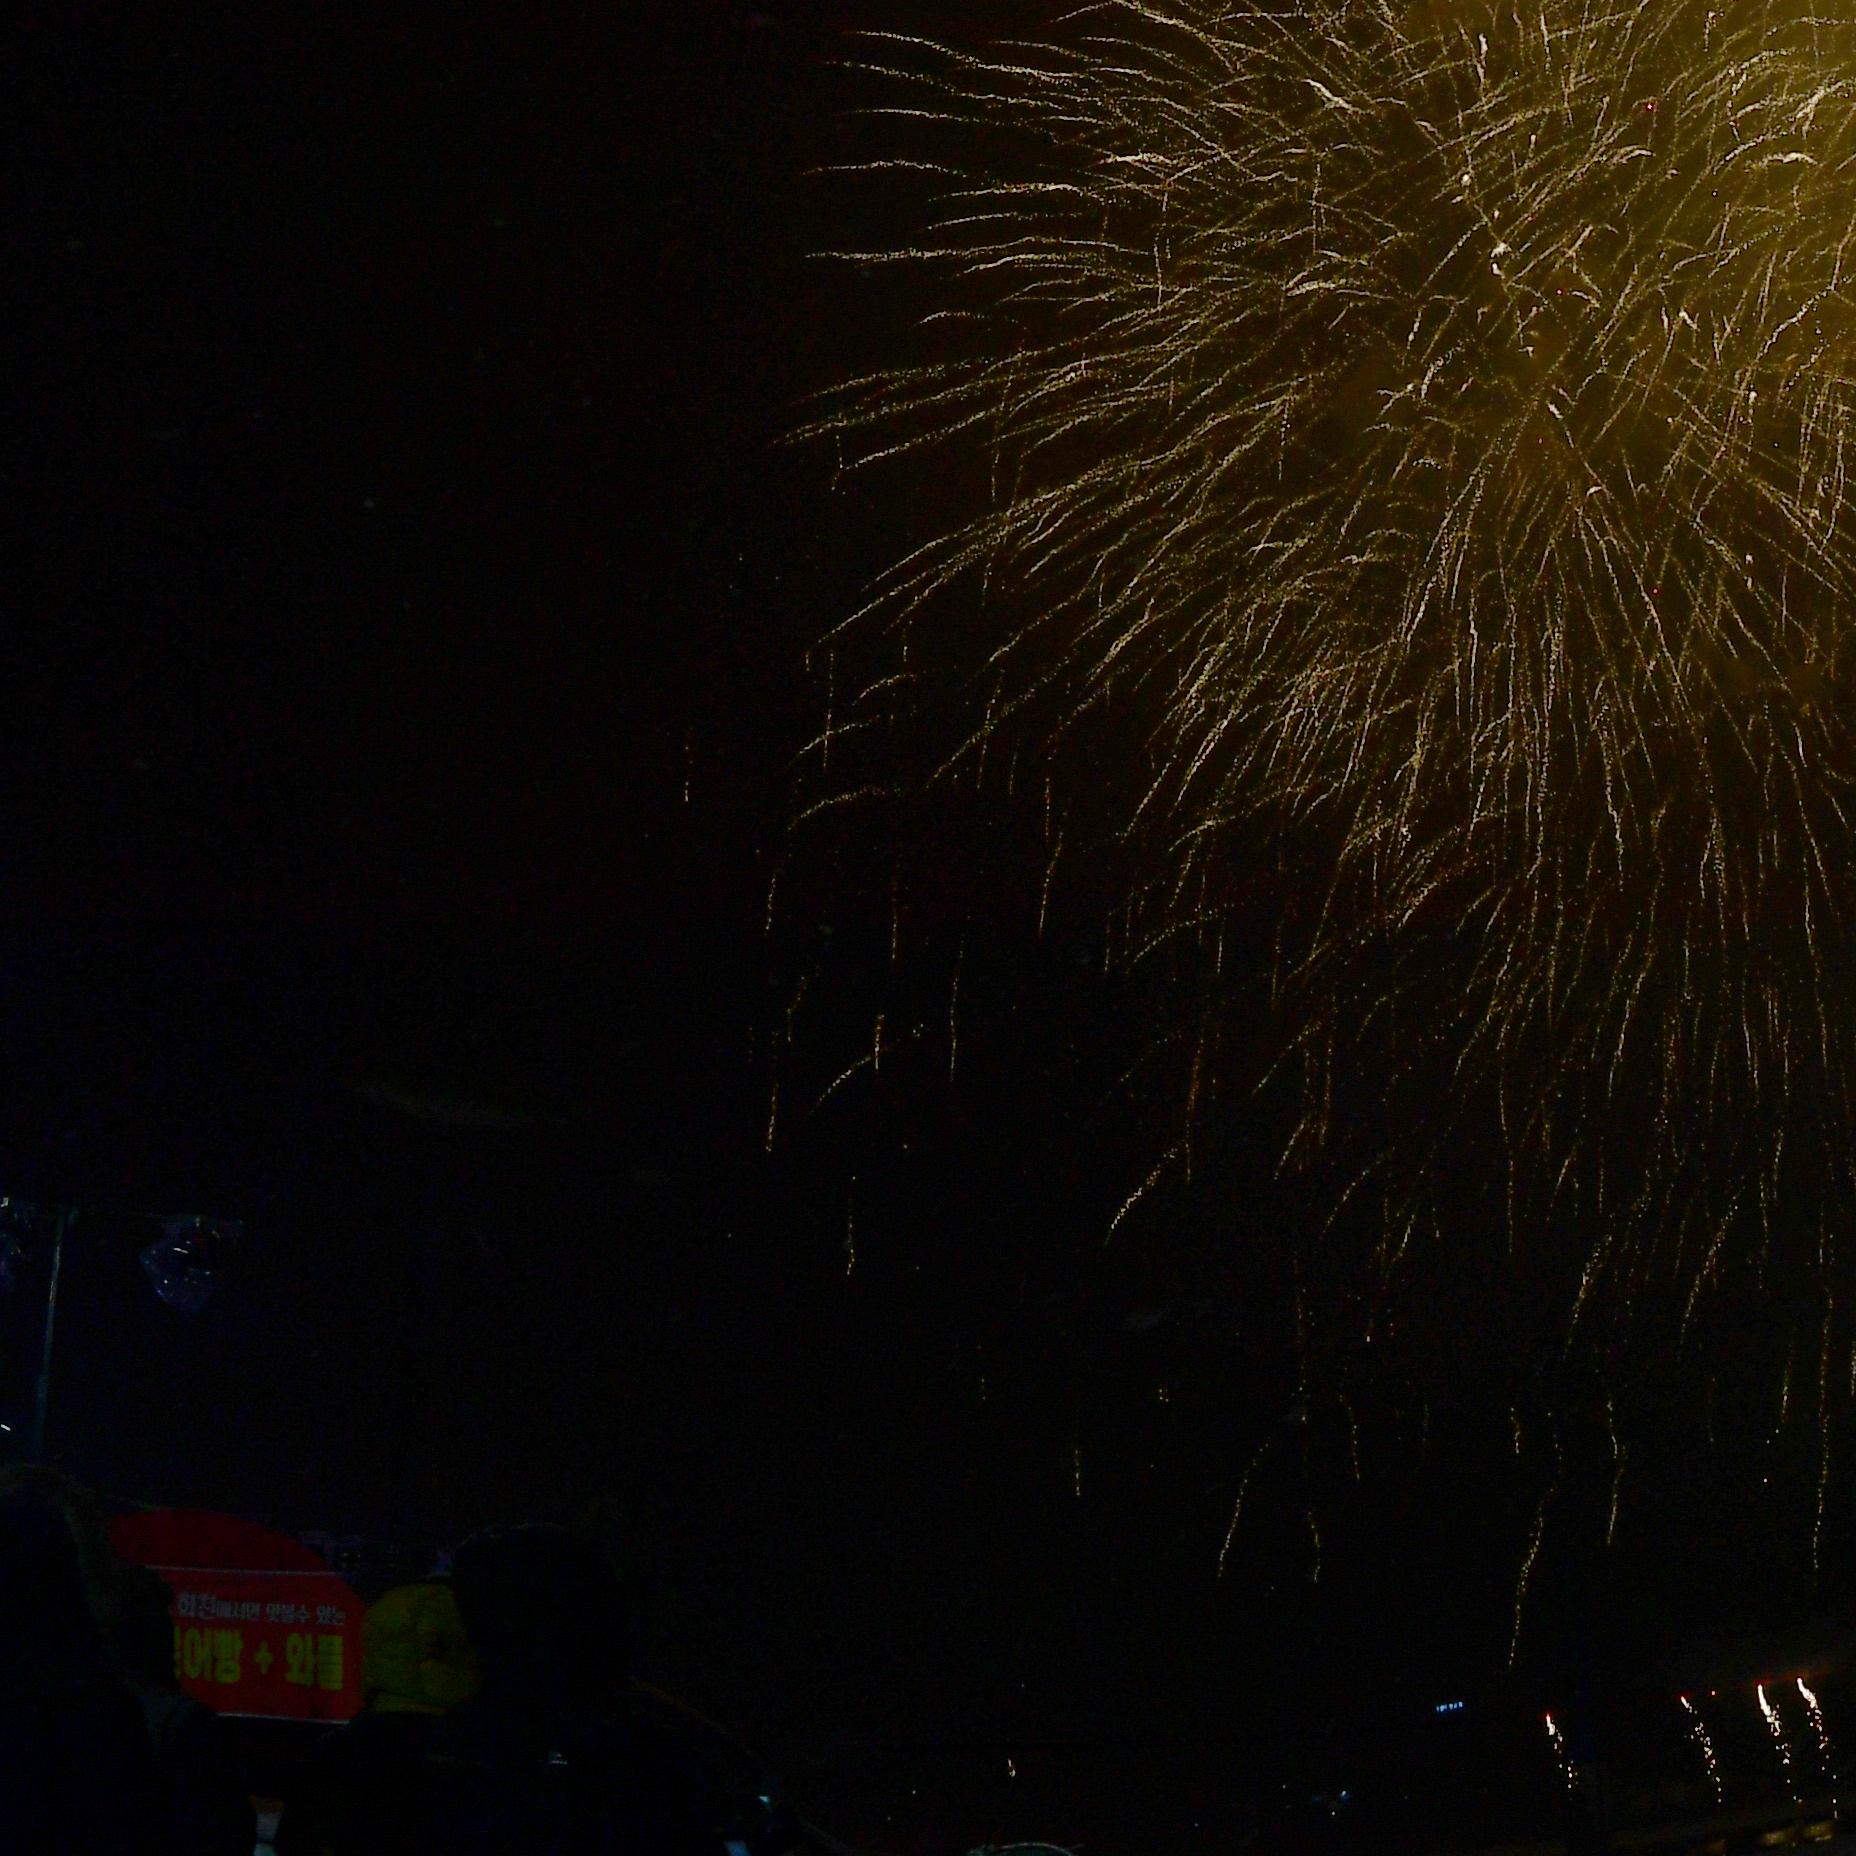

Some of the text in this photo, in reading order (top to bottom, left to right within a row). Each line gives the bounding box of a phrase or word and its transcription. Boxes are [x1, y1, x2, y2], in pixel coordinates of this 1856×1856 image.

[315, 1604, 347, 1626] 있는
[174, 1624, 244, 1686] 어빵
[285, 1631, 346, 1693] 와플
